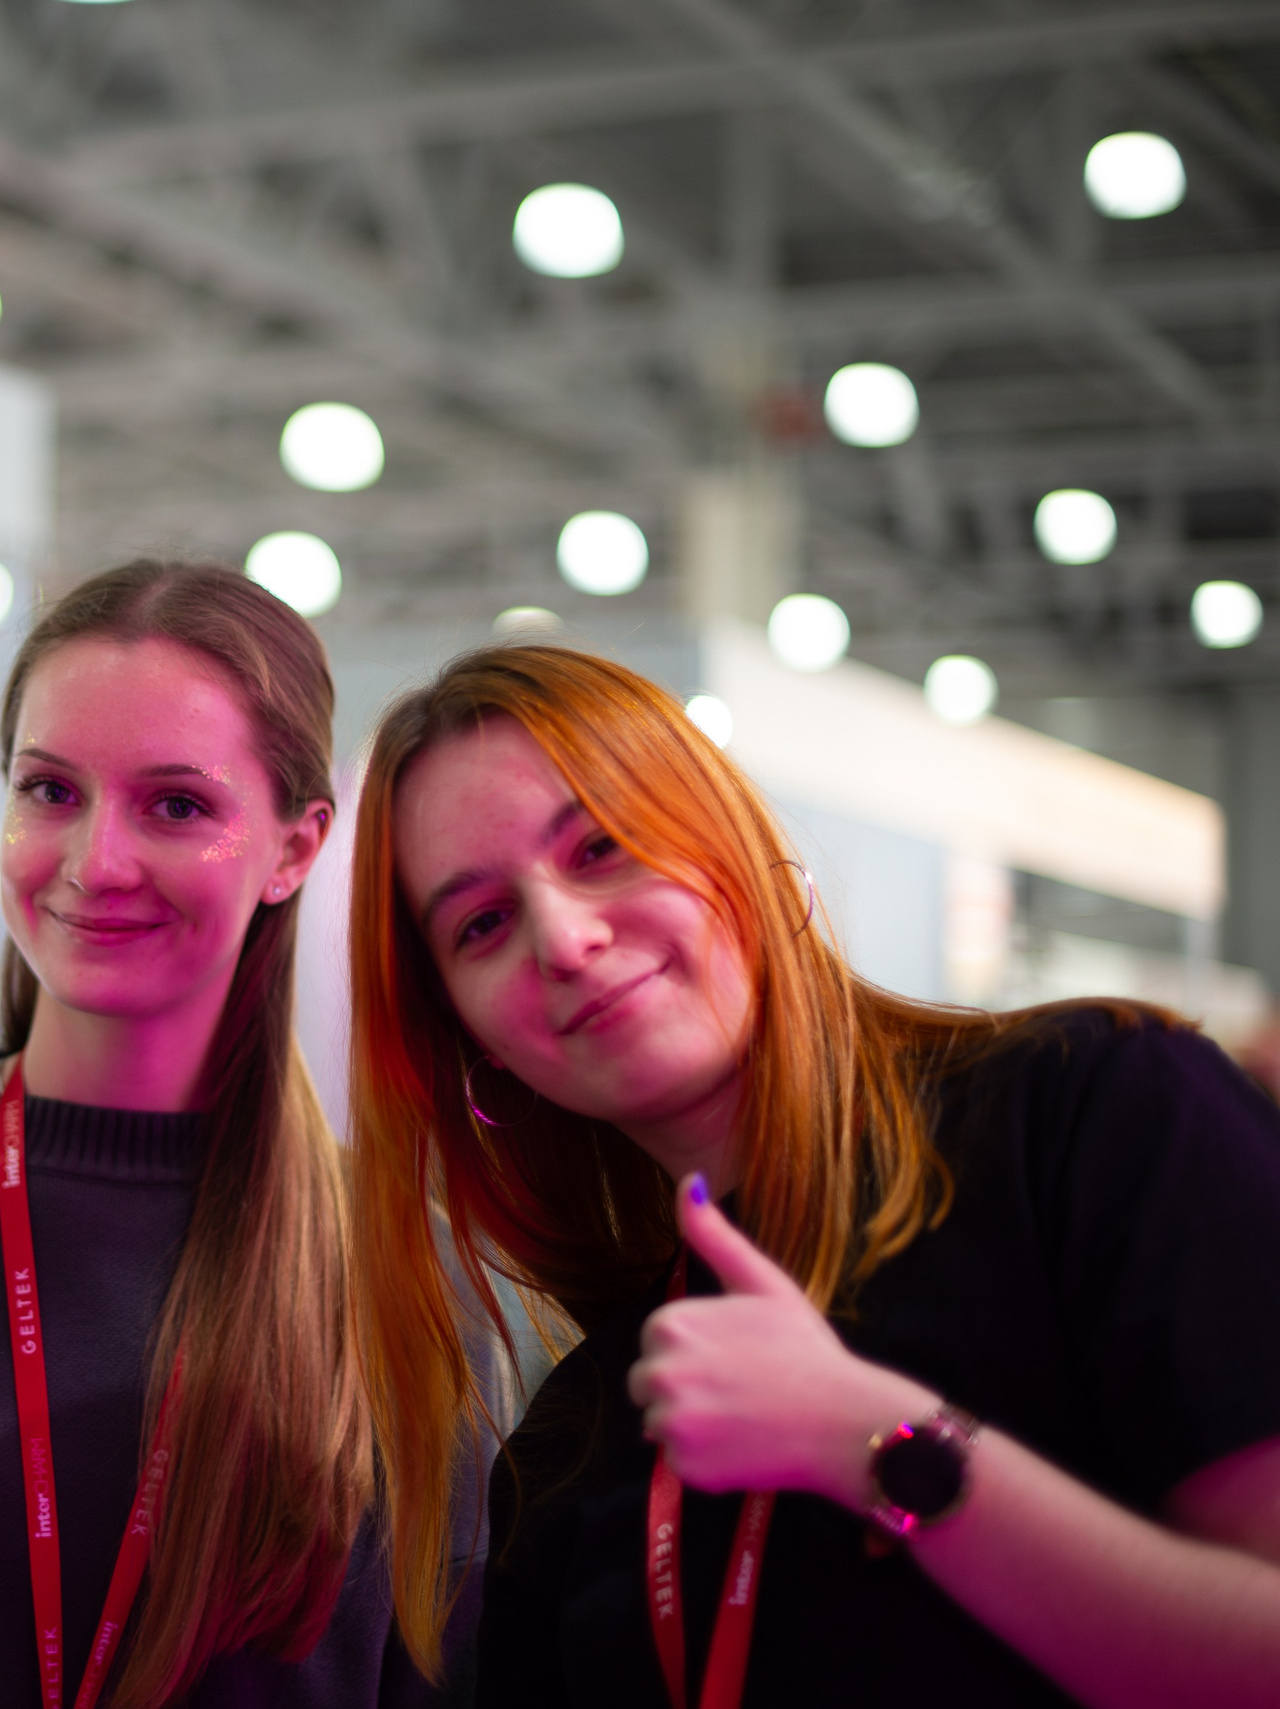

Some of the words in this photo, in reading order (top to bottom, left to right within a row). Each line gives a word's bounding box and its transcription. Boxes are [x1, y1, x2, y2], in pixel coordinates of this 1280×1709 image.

[14, 1267, 37, 1355] GELTEK
[131, 1449, 170, 1535] GELTEK
[655, 1523, 674, 1620] GELTEK
